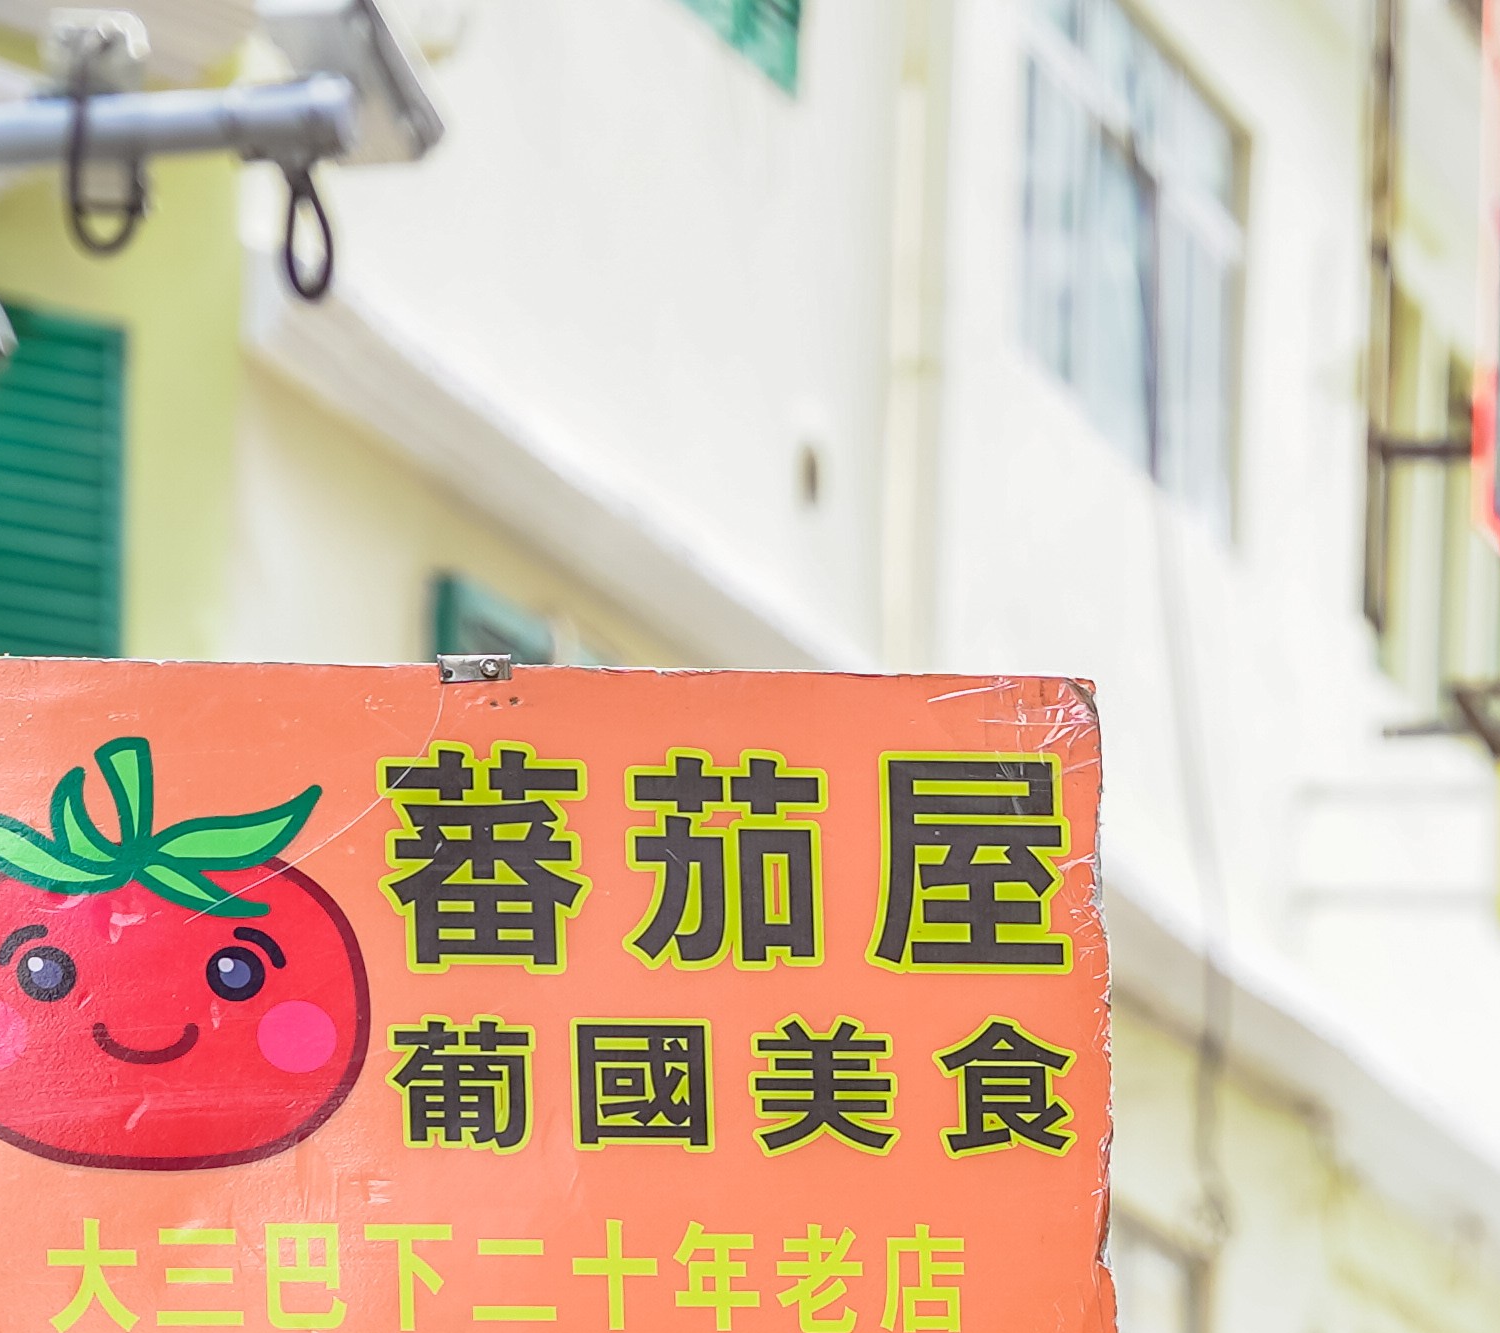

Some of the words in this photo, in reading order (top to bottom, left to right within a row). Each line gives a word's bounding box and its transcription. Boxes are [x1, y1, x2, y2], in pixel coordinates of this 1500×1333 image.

[377, 741, 1074, 975] 蕃茄屋
[386, 1016, 1077, 1156] 葡國美食
